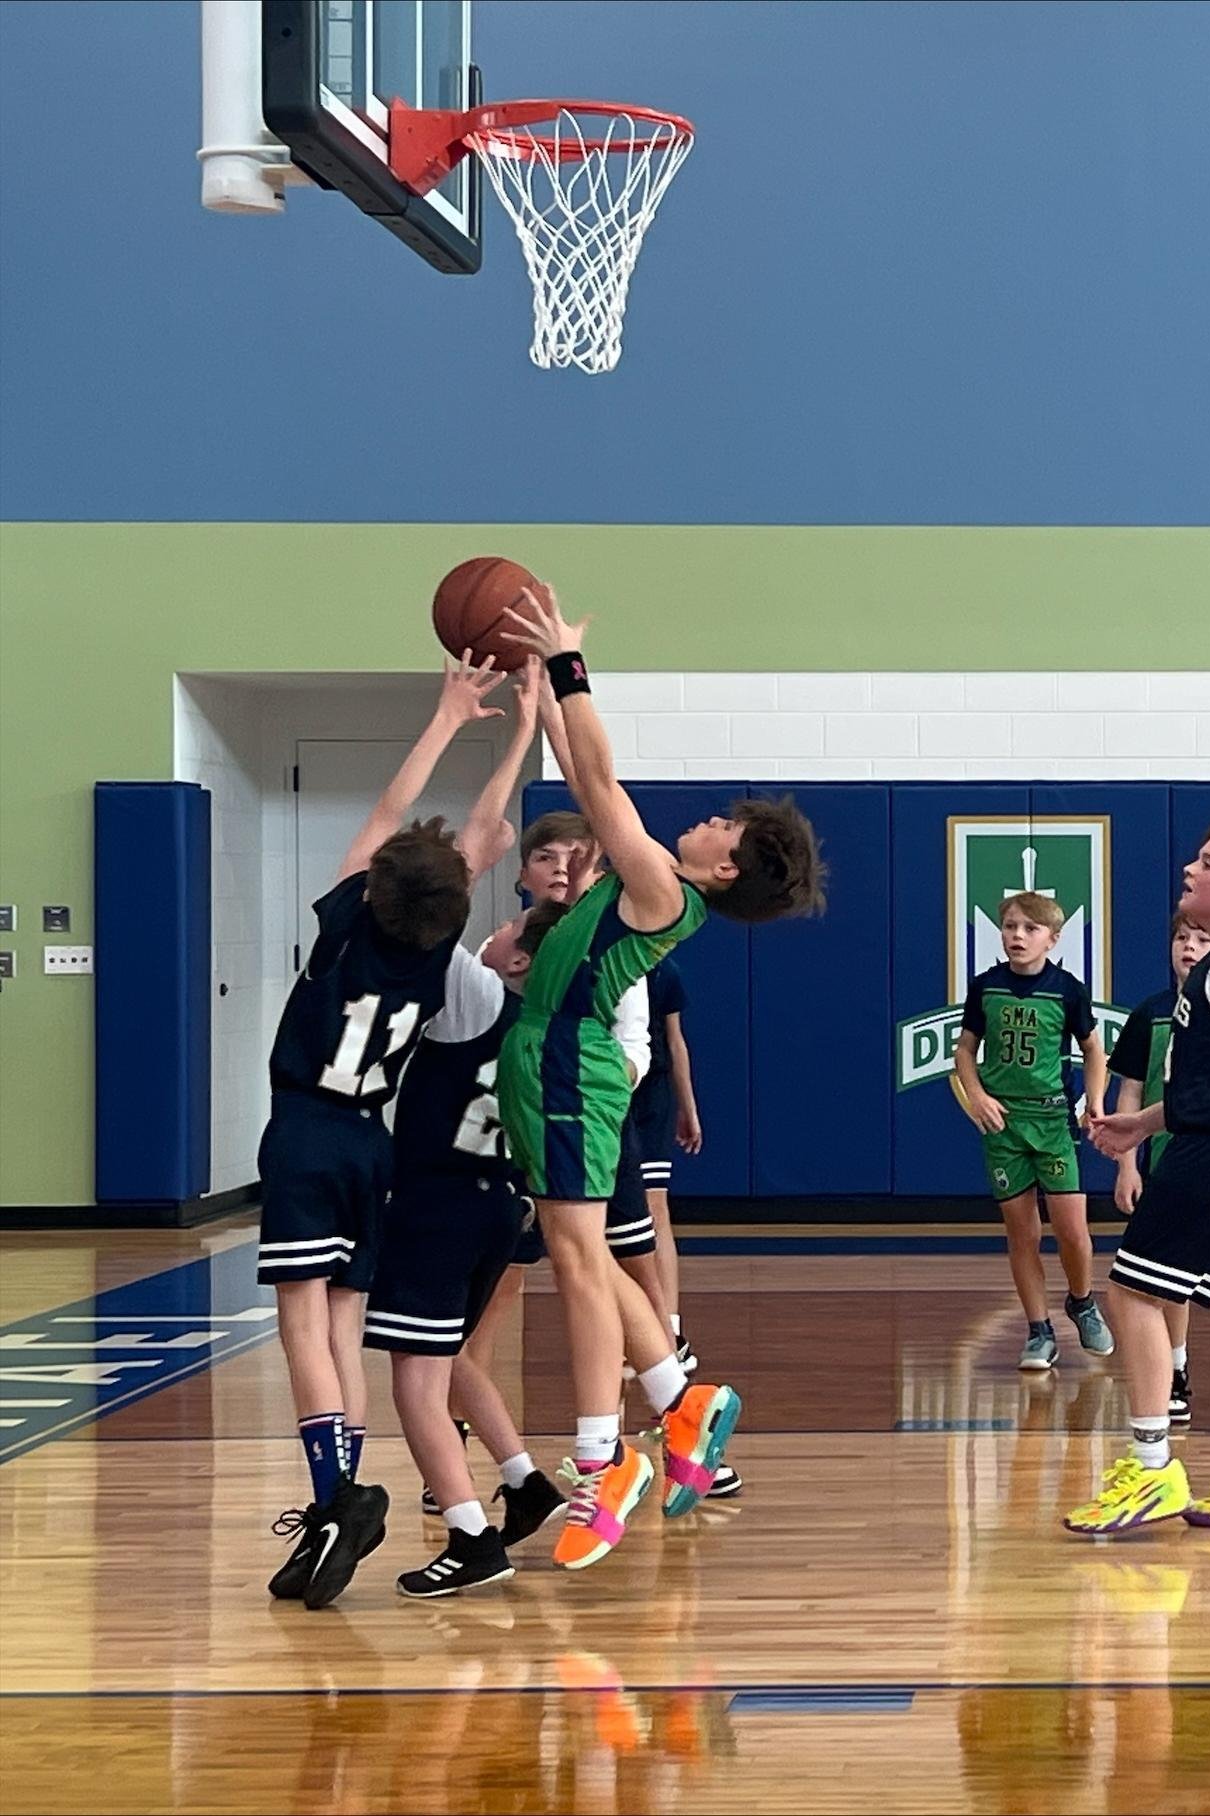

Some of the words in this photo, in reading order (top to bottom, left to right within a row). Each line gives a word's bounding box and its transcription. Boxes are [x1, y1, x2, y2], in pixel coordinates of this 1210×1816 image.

[1000, 1004, 1038, 1028] SMA
[318, 993, 421, 1097] 11
[999, 1029, 1039, 1068] 35
